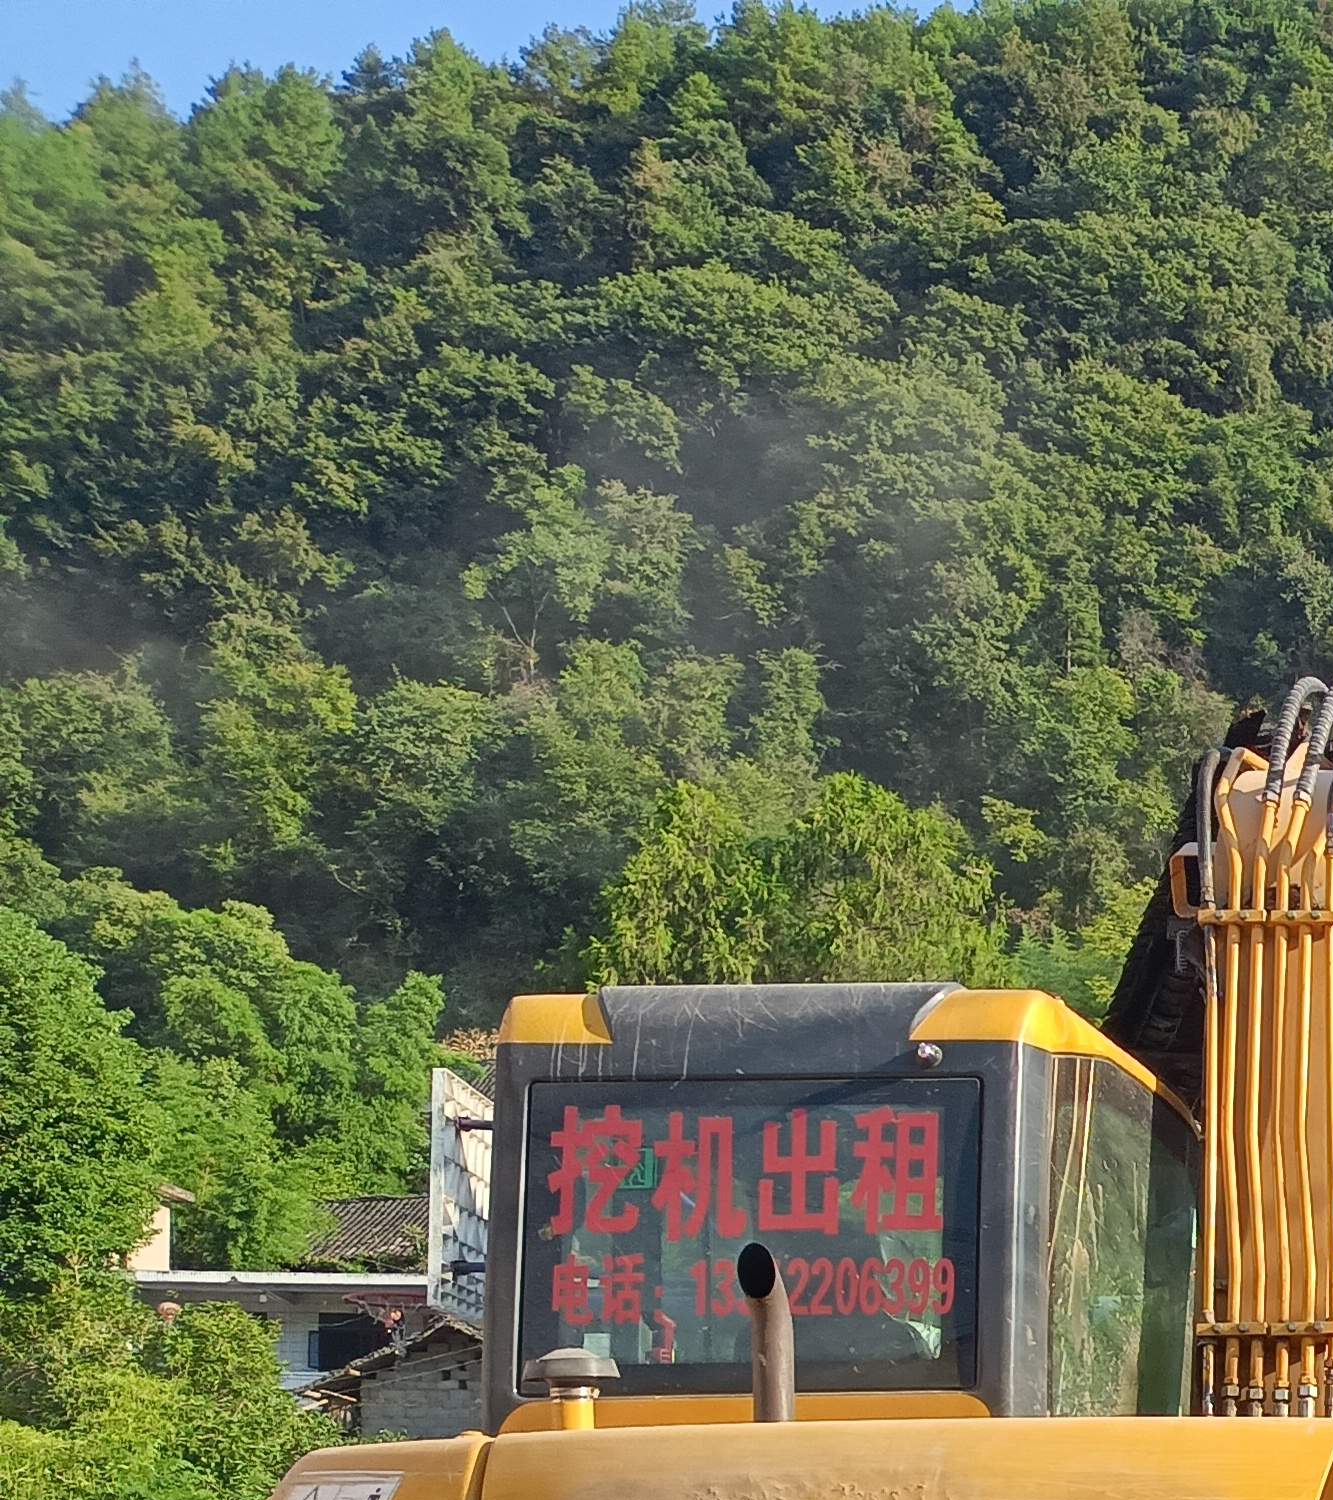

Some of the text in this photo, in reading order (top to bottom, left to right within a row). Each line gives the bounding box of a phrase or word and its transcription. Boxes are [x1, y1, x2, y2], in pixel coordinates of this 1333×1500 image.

[548, 1104, 944, 1242] 挖机出租
[690, 1257, 956, 1318] 132206399
